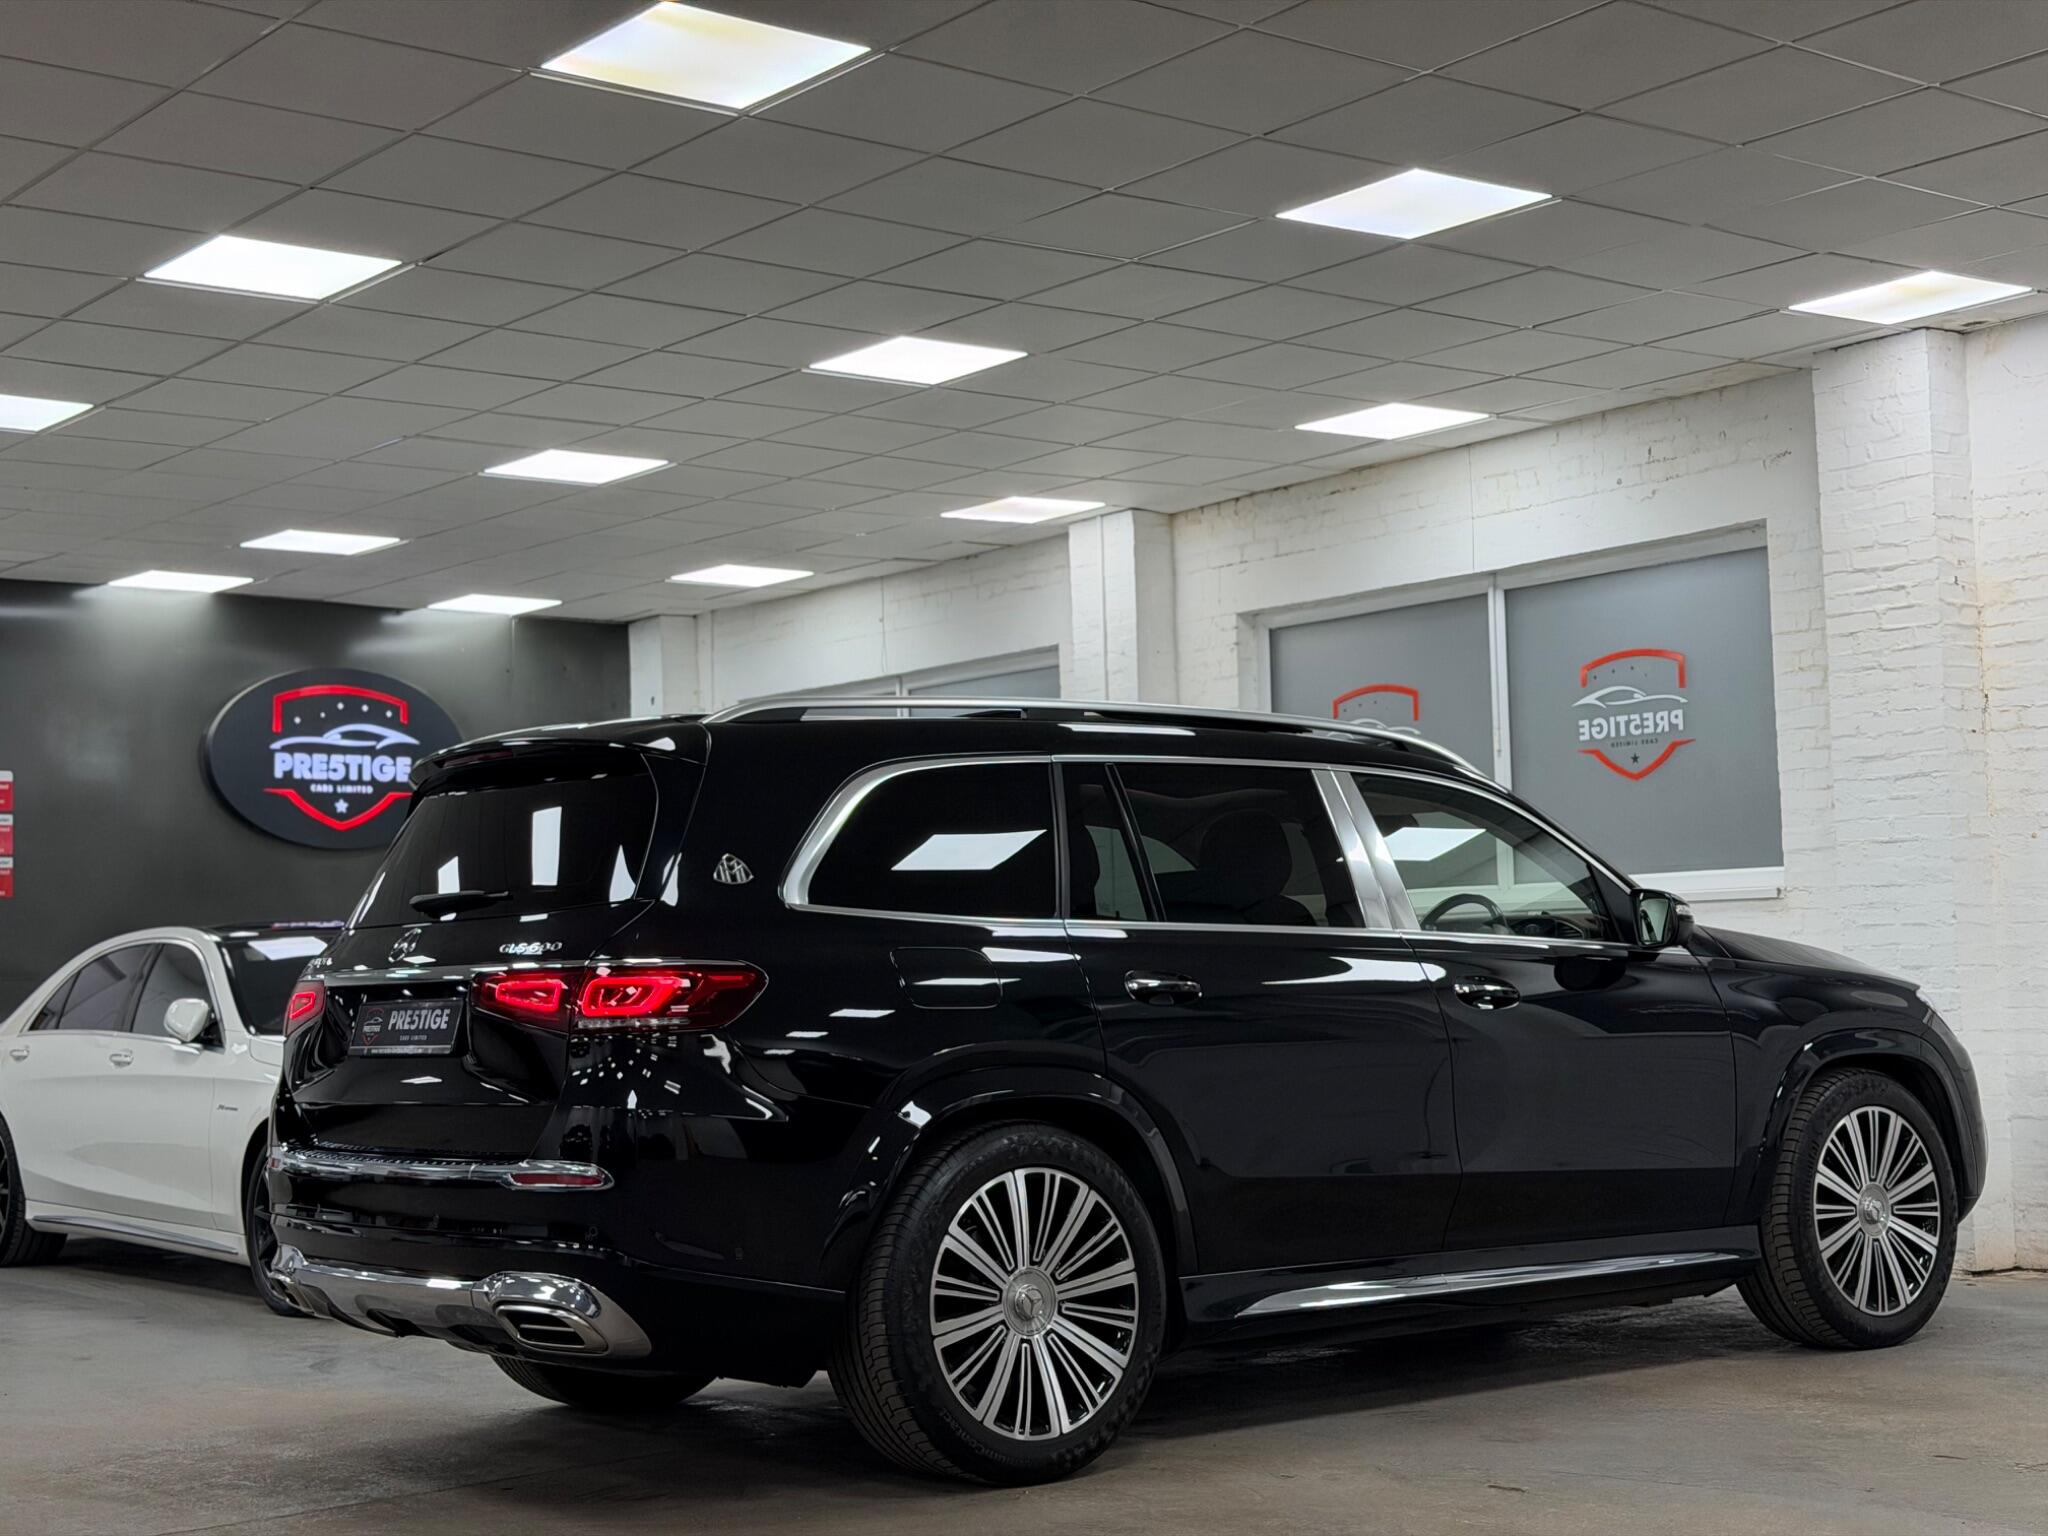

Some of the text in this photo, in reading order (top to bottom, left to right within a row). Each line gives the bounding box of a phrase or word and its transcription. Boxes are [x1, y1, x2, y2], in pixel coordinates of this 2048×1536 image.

[274, 752, 412, 783] PRESTIGE
[310, 783, 374, 794] CARS LIMITED
[388, 1008, 450, 1030] PRESTIGE
